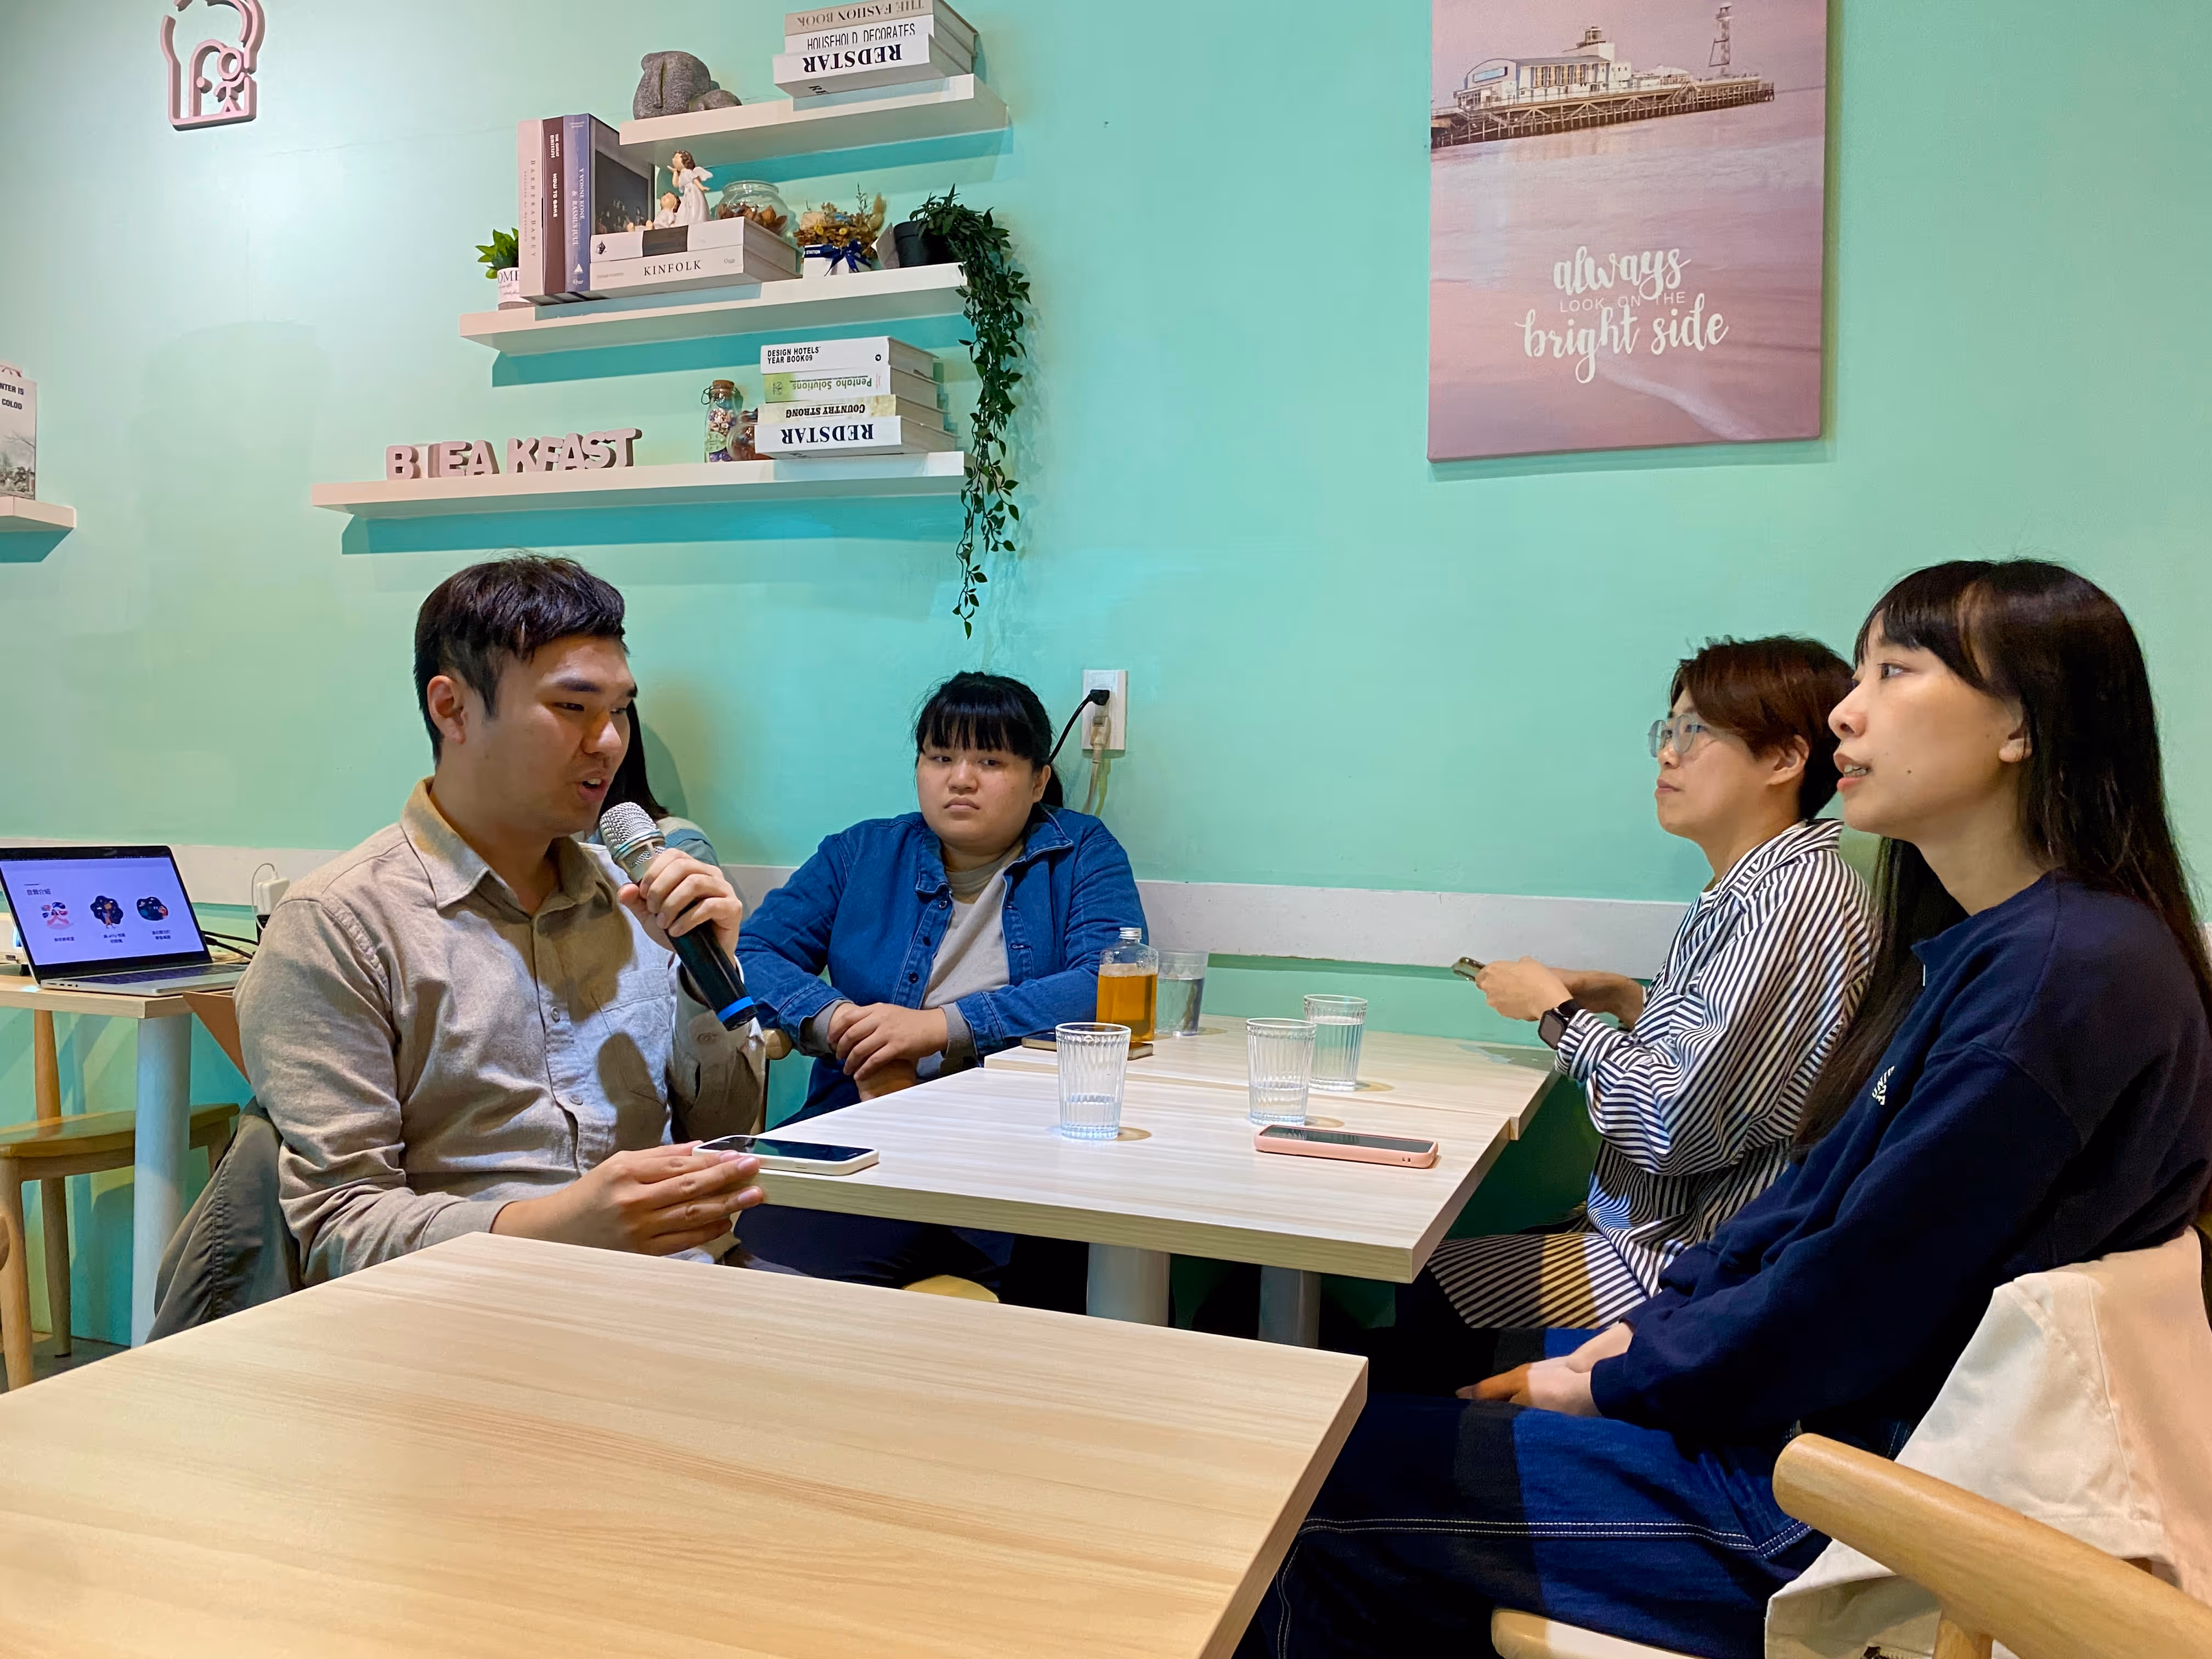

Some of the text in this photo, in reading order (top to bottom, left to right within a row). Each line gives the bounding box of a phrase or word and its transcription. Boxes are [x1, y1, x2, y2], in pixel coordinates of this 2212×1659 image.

[838, 3, 892, 21] FASHION
[797, 13, 833, 27] BOOK
[803, 44, 902, 72] REDSTAR
[552, 190, 557, 198] TO
[644, 260, 702, 275] KINFOLK
[1554, 246, 1691, 300] always
[1560, 298, 1604, 312] LOOK
[1618, 295, 1640, 308] ON
[1515, 293, 1729, 383] bright side
[768, 346, 819, 357] DESIGN HOTELS
[792, 381, 832, 391] Solutions
[836, 378, 872, 389] Pentaho
[786, 404, 865, 418] COUNTRY STRONG
[780, 423, 873, 444] REDSTAR
